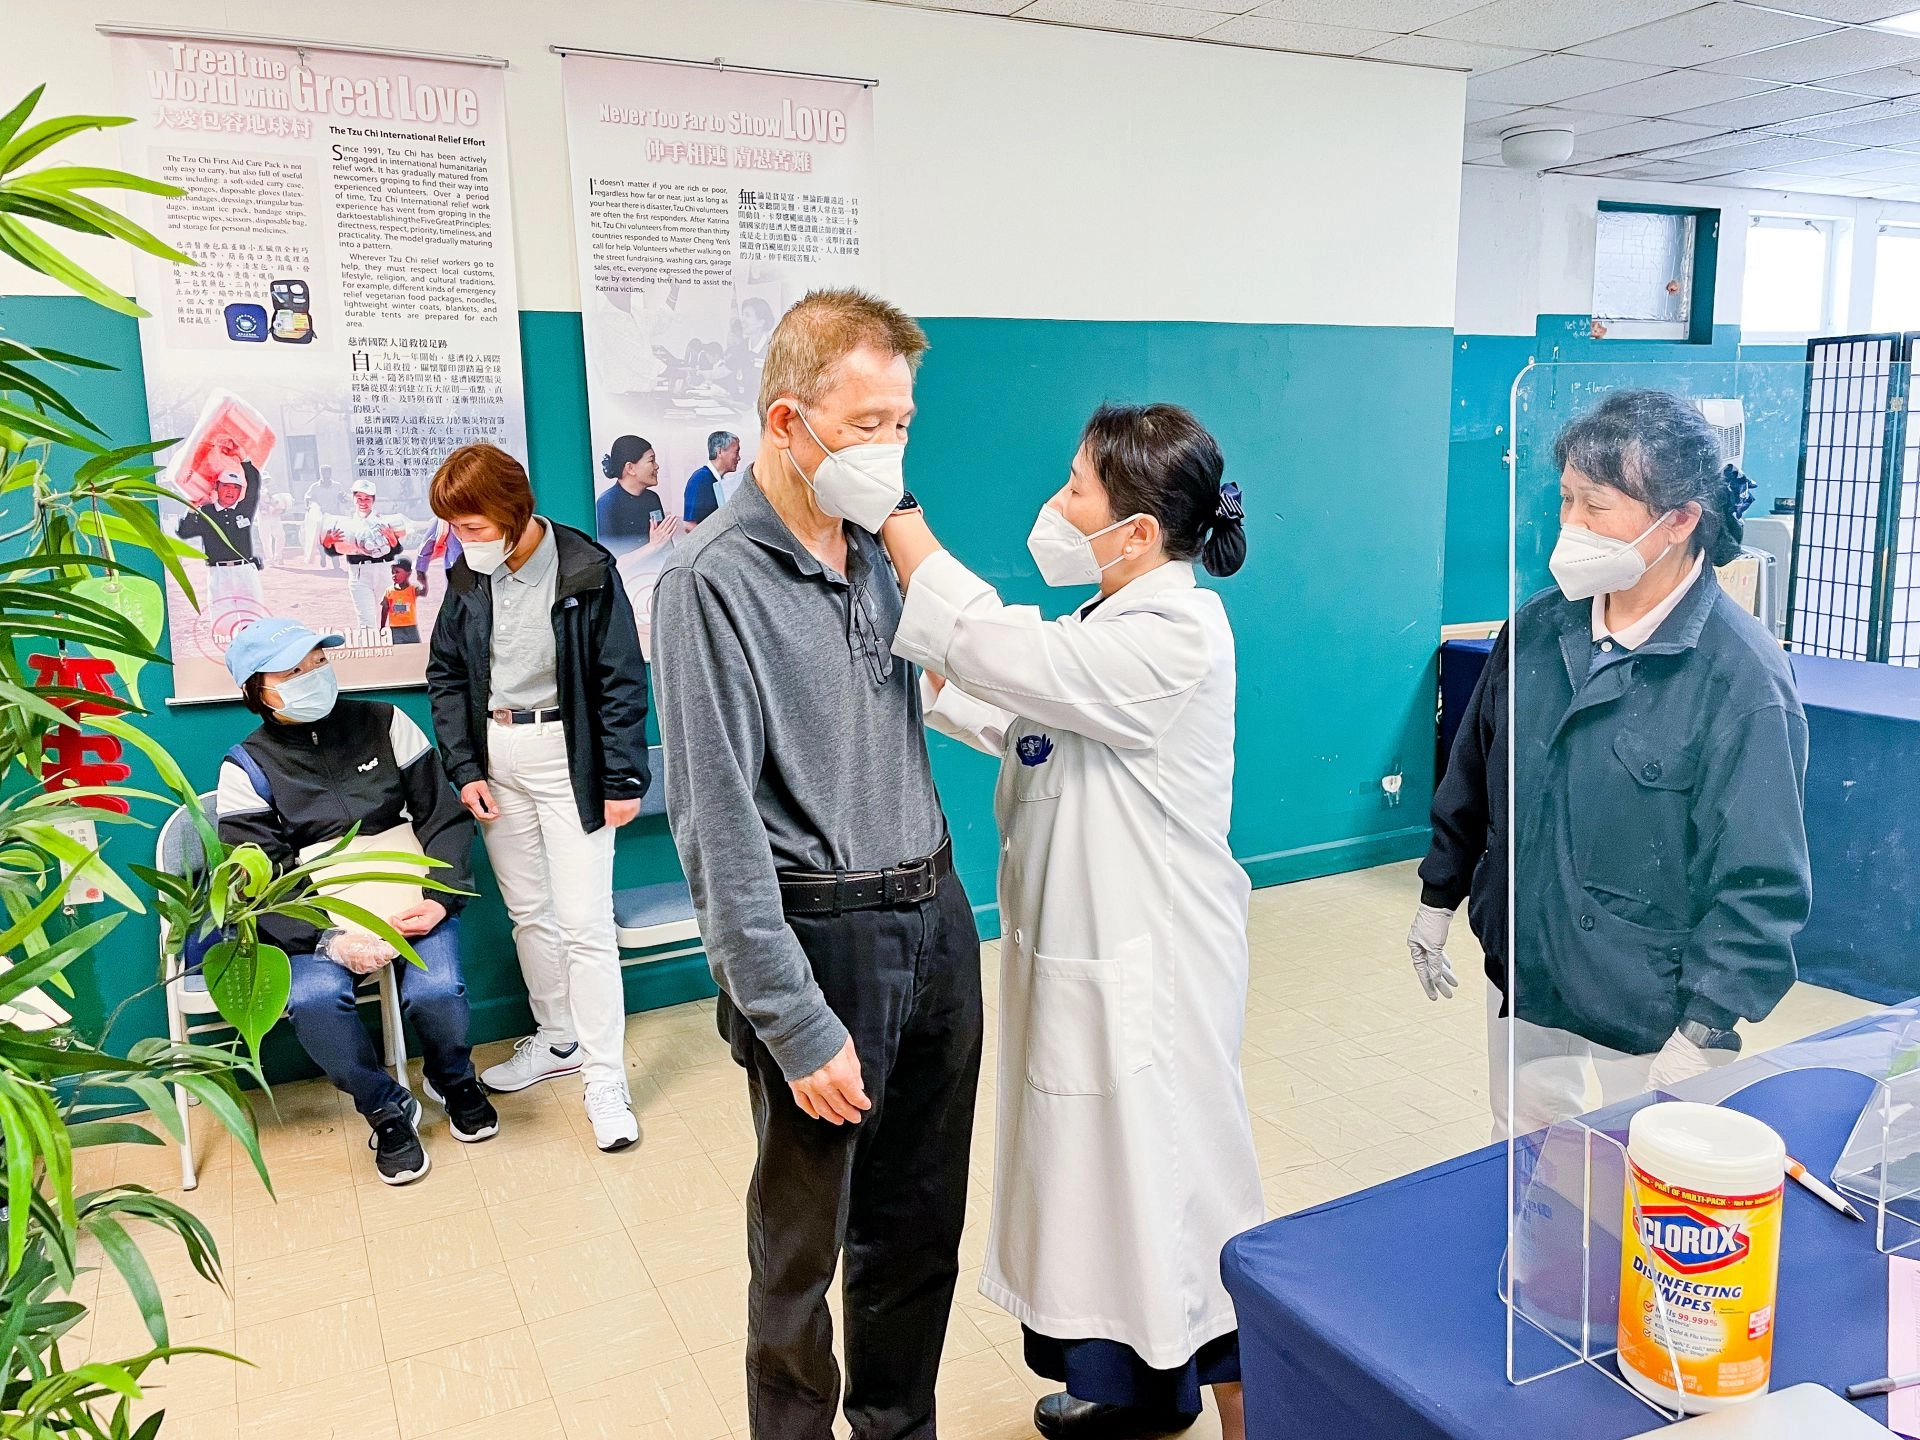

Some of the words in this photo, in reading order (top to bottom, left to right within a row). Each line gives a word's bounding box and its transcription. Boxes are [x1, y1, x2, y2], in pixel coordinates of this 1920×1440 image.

[168, 43, 248, 76] Treat
[250, 57, 286, 80] the
[147, 70, 238, 104] World
[244, 88, 289, 110] with
[289, 66, 392, 118] Great
[399, 76, 478, 126] Love
[153, 106, 312, 140] 大愛包容地球村
[600, 104, 648, 126] Never
[650, 109, 678, 128] Too
[682, 112, 706, 131] Far
[709, 113, 725, 132] to
[728, 110, 782, 137] Show
[782, 98, 846, 144] Love
[328, 124, 346, 135] The
[347, 126, 363, 137] Tzu
[364, 127, 379, 138] Chi
[380, 128, 436, 143] International
[438, 133, 461, 145] Relief
[462, 135, 486, 147] Effort
[166, 154, 181, 163] The
[183, 155, 197, 164] Tzu
[198, 156, 211, 165] Chi
[213, 157, 229, 166] First
[231, 158, 244, 166] Aid
[246, 159, 262, 168] Care
[264, 160, 281, 169] Pack
[364, 146, 384, 158] 1991,
[388, 148, 401, 157] Tzu
[404, 149, 417, 159] Chi
[420, 150, 434, 160] has
[437, 151, 456, 161] been
[460, 154, 487, 166] actively
[646, 139, 728, 166] 伸手相連
[332, 163, 352, 173] relief
[386, 166, 399, 176] has
[401, 168, 436, 181] gradually
[438, 172, 469, 181] matured
[470, 172, 488, 182] from
[344, 156, 378, 167] engaged
[380, 157, 388, 166] in
[390, 158, 438, 170] international
[439, 161, 488, 173] humanitarian
[334, 175, 378, 184] newcomers
[380, 176, 410, 188] groping
[412, 178, 420, 187] to
[422, 178, 437, 188] find
[439, 180, 456, 189] their
[458, 183, 473, 193] way
[474, 182, 491, 192] into
[334, 183, 382, 194] experienced
[387, 186, 428, 197] volunteers.
[433, 188, 451, 198] Over
[466, 191, 490, 202] period
[600, 177, 624, 188] doesn't
[627, 181, 650, 189] matter
[660, 184, 672, 193] you
[687, 183, 700, 193] rich
[711, 188, 728, 196] poor,
[335, 191, 343, 200] of
[369, 193, 382, 203] Tzu
[385, 194, 398, 204] Chi
[401, 196, 449, 208] International
[451, 199, 469, 209] relief
[472, 201, 490, 210] work
[590, 201, 605, 210] your
[622, 200, 639, 210] there
[646, 202, 673, 213] disaster,
[673, 203, 684, 212] Tzu
[684, 204, 696, 213] Chi
[696, 205, 729, 215] volunteers
[594, 189, 629, 200] regardless
[630, 190, 645, 200] how
[646, 191, 656, 200] far
[683, 193, 695, 205] just
[705, 195, 720, 207] long
[336, 202, 378, 213] experience
[380, 204, 394, 213] has
[396, 206, 415, 214] went
[417, 206, 436, 216] from
[438, 208, 467, 220] groping
[469, 209, 476, 218] in
[478, 210, 491, 219] the
[603, 210, 621, 220] often
[623, 211, 634, 220] the
[636, 212, 649, 221] first
[690, 214, 706, 224] After
[707, 215, 730, 225] Katrina
[603, 220, 615, 230] Tzu
[615, 221, 627, 230] Chi
[627, 222, 662, 232] volunteers
[662, 223, 679, 233] from
[697, 225, 712, 234] than
[713, 226, 730, 238] thirty
[591, 232, 623, 241] countries
[624, 233, 660, 244] responded
[661, 235, 669, 243] to
[670, 234, 692, 244] Master
[693, 235, 714, 247] Cheng
[349, 252, 386, 263] Wherever
[389, 254, 402, 264] Tzu
[405, 255, 418, 264] Chi
[420, 256, 439, 266] relief
[442, 258, 471, 267] workers
[473, 261, 484, 270] go
[486, 260, 494, 268] to
[348, 336, 448, 349] 慈濟國際人道救援足跡
[212, 634, 232, 644] The
[1654, 1181, 1670, 1194] PART
[1671, 1188, 1681, 1196] OF
[1682, 1192, 1726, 1206] MULTI-PACK
[1641, 1217, 1740, 1255] CLOROX
[1633, 1256, 1742, 1298] DISINFECTING
[1658, 1284, 1712, 1312] WIPES
